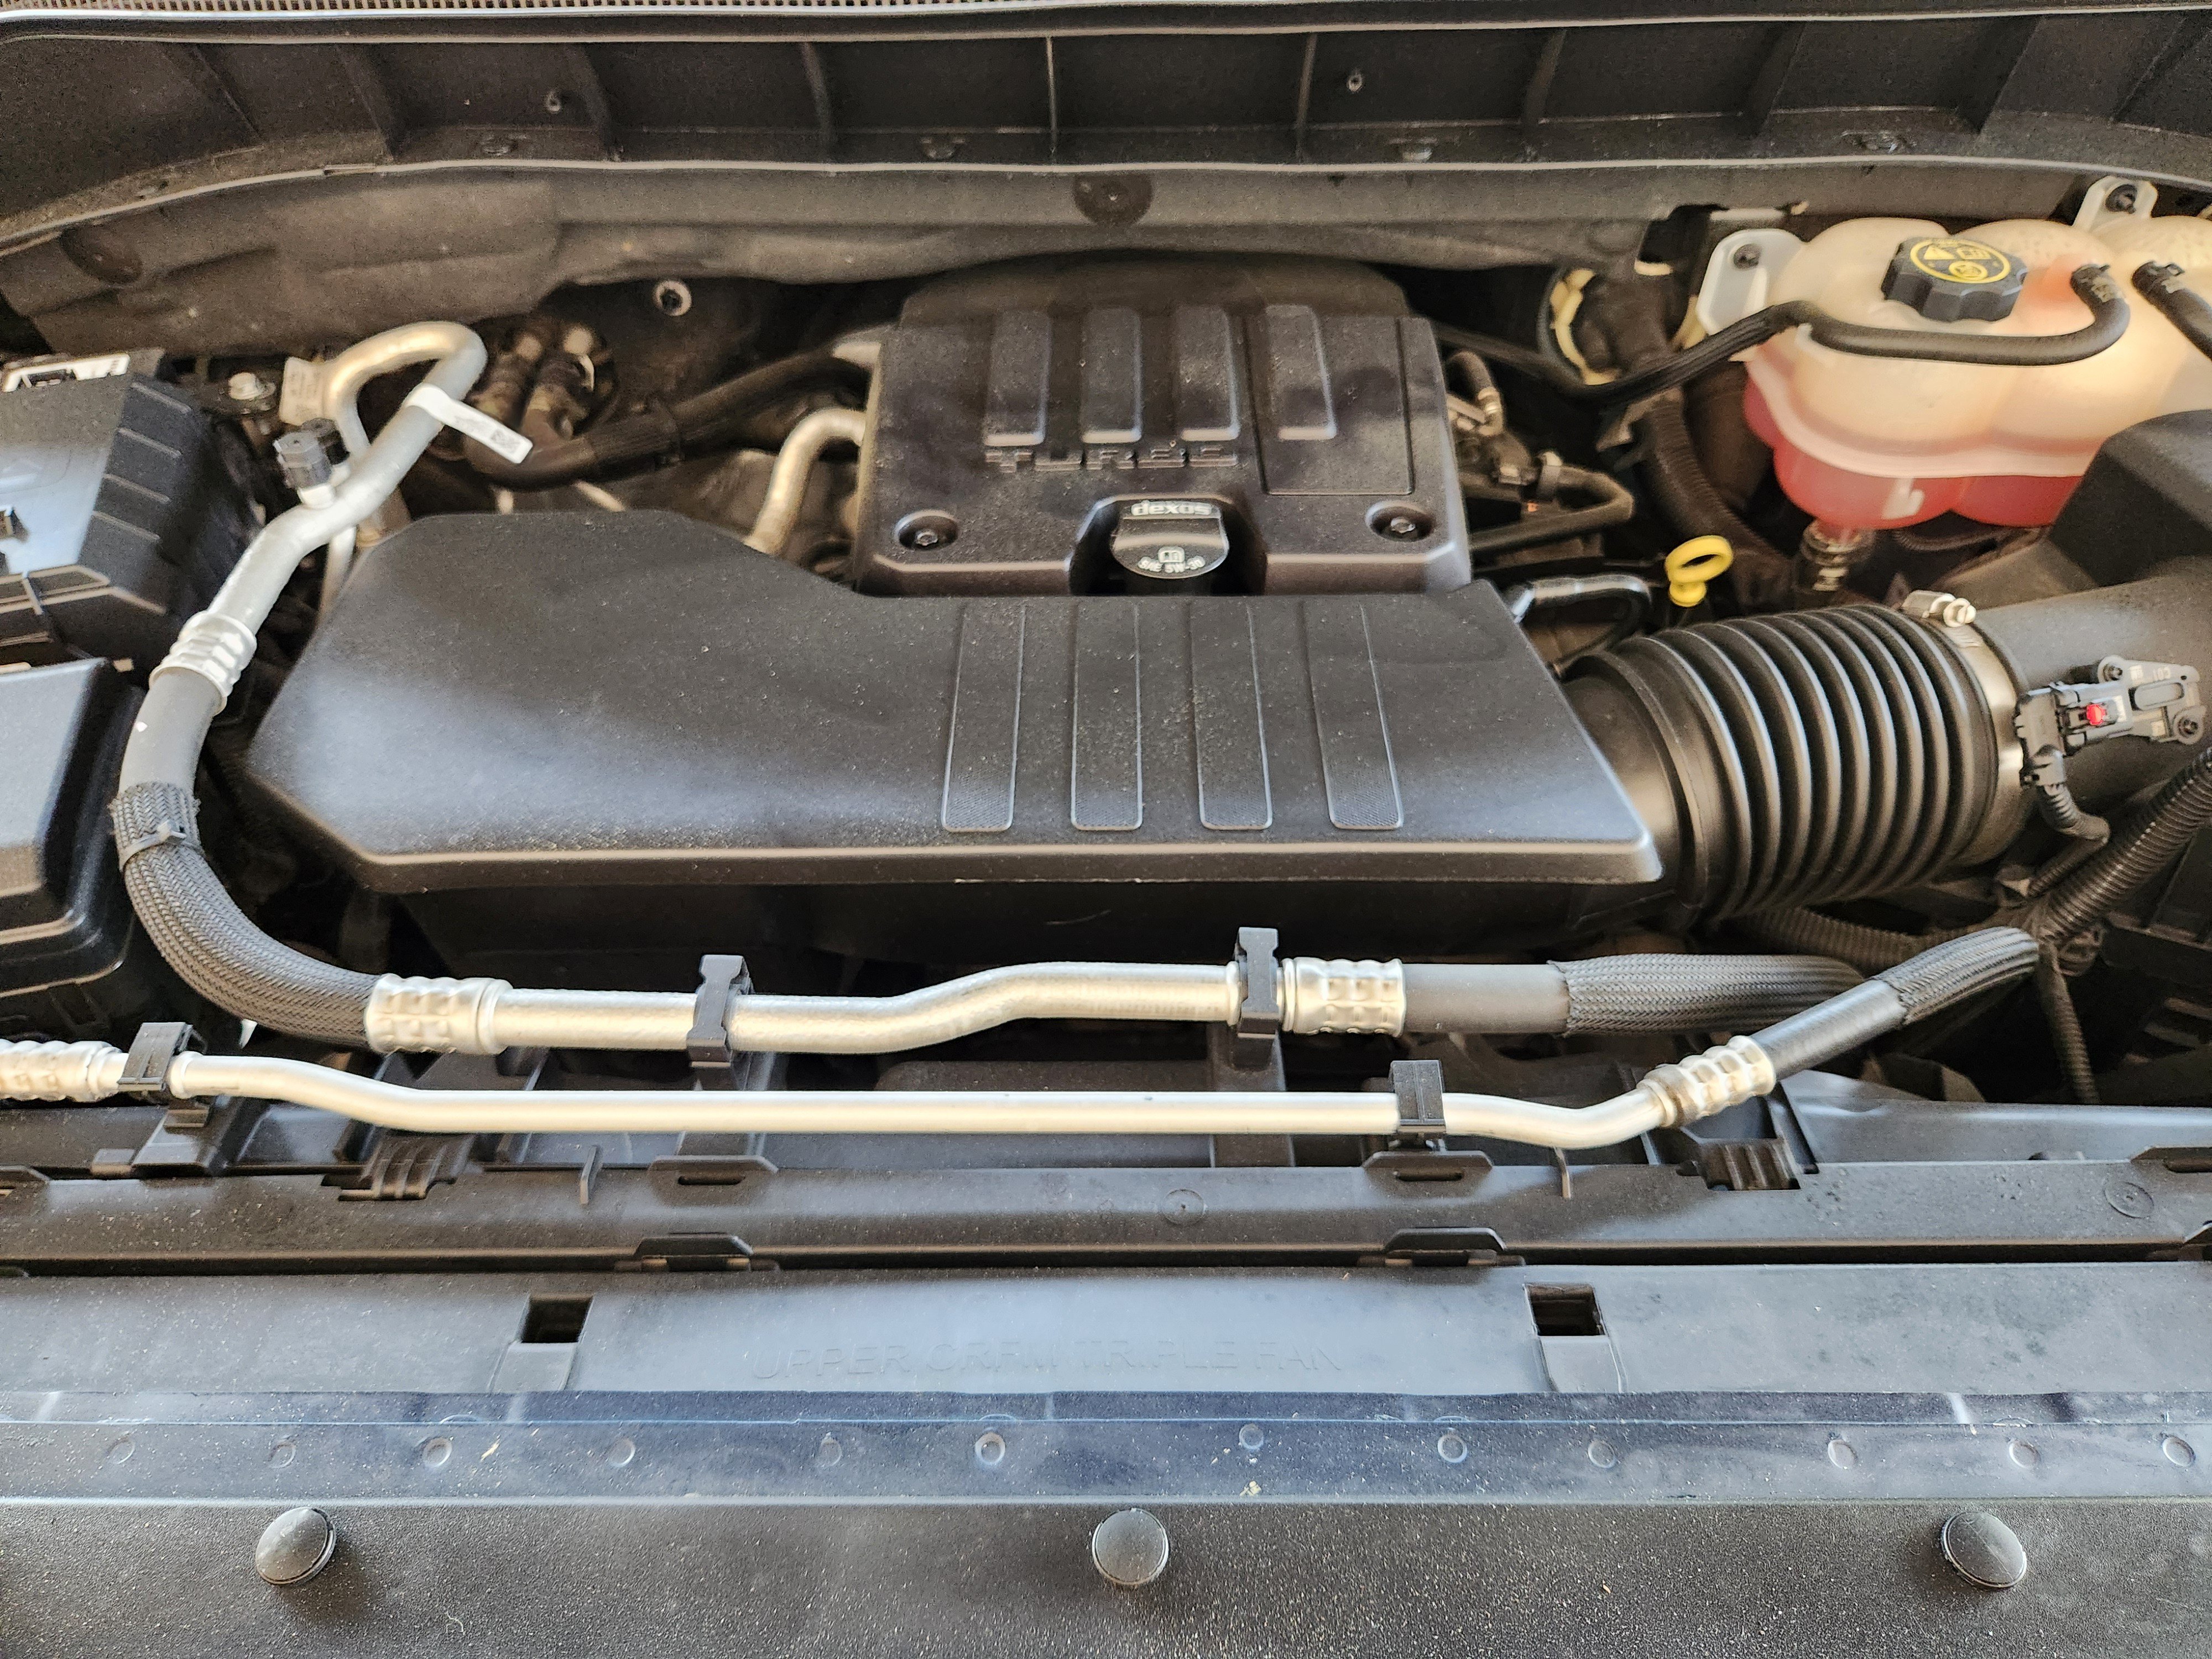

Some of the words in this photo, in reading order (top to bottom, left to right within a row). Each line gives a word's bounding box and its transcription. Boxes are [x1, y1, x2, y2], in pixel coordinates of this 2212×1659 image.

[1131, 501, 1211, 515] dexos
[1138, 557, 1162, 572] SAE
[1165, 556, 1205, 573] 5W-30
[753, 1344, 910, 1379] UPPER
[1074, 1340, 1238, 1369] TRIPLE
[1256, 1340, 1343, 1371] FAN
